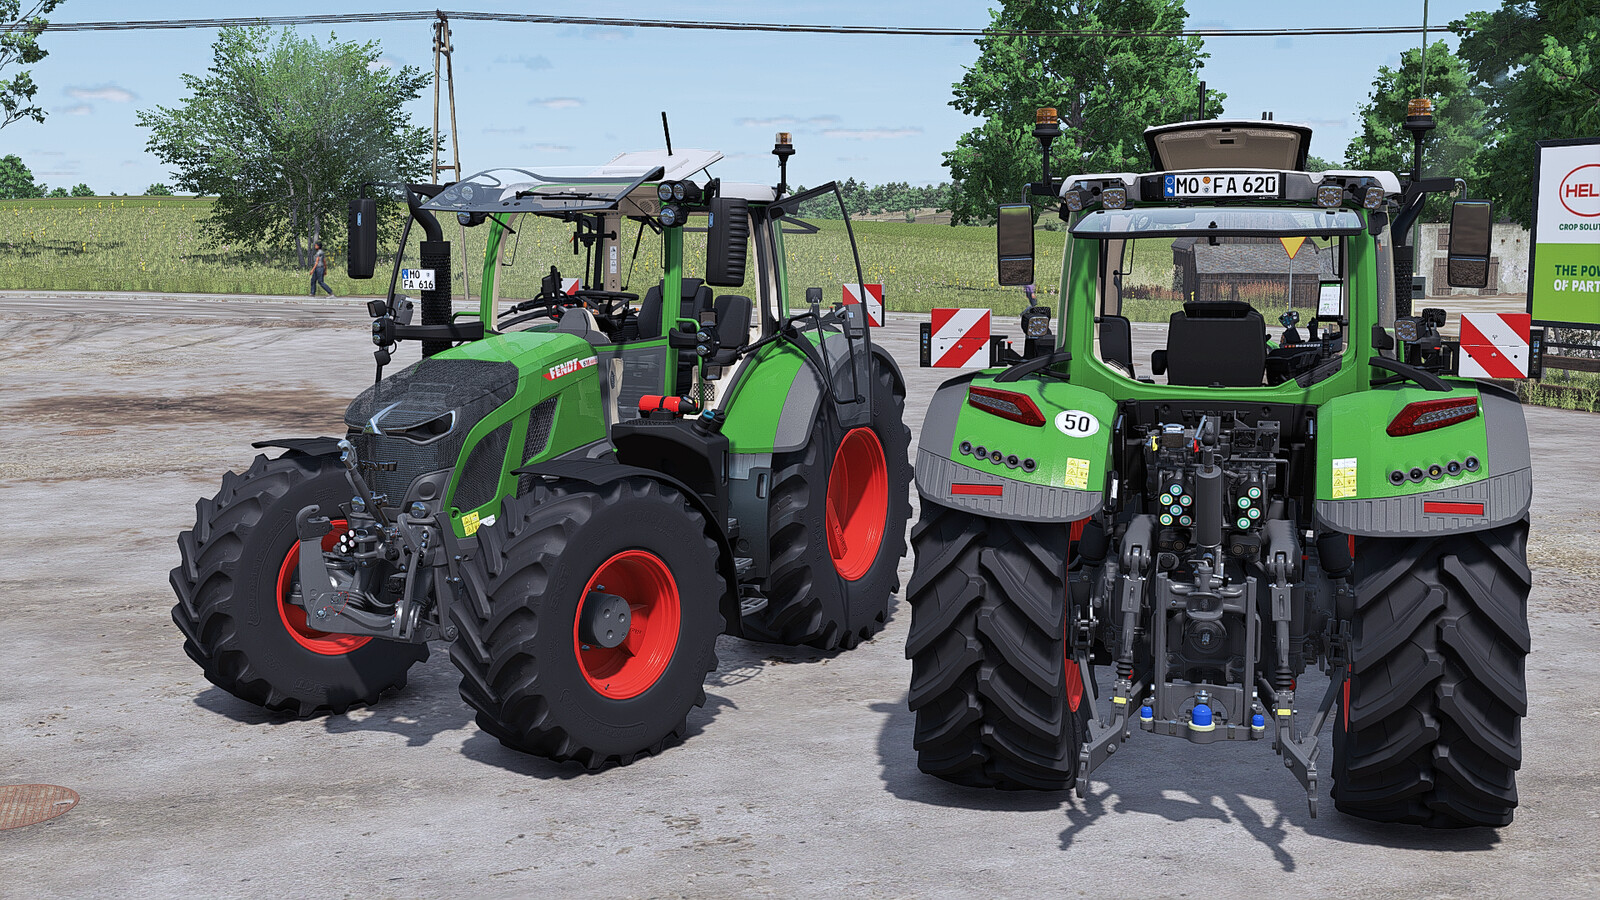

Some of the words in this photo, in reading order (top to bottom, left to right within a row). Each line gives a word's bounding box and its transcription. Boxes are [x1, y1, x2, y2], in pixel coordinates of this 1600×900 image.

[1176, 177, 1199, 194] MO
[1213, 177, 1237, 194] FA
[1242, 177, 1276, 193] 620
[1559, 223, 1578, 231] CROP
[409, 270, 421, 279] MO
[1554, 264, 1578, 276] THE
[404, 280, 414, 289] FA
[418, 280, 434, 289] 616
[1554, 279, 1569, 291] OF
[549, 358, 579, 380] FENDT
[1064, 413, 1091, 433] 50
